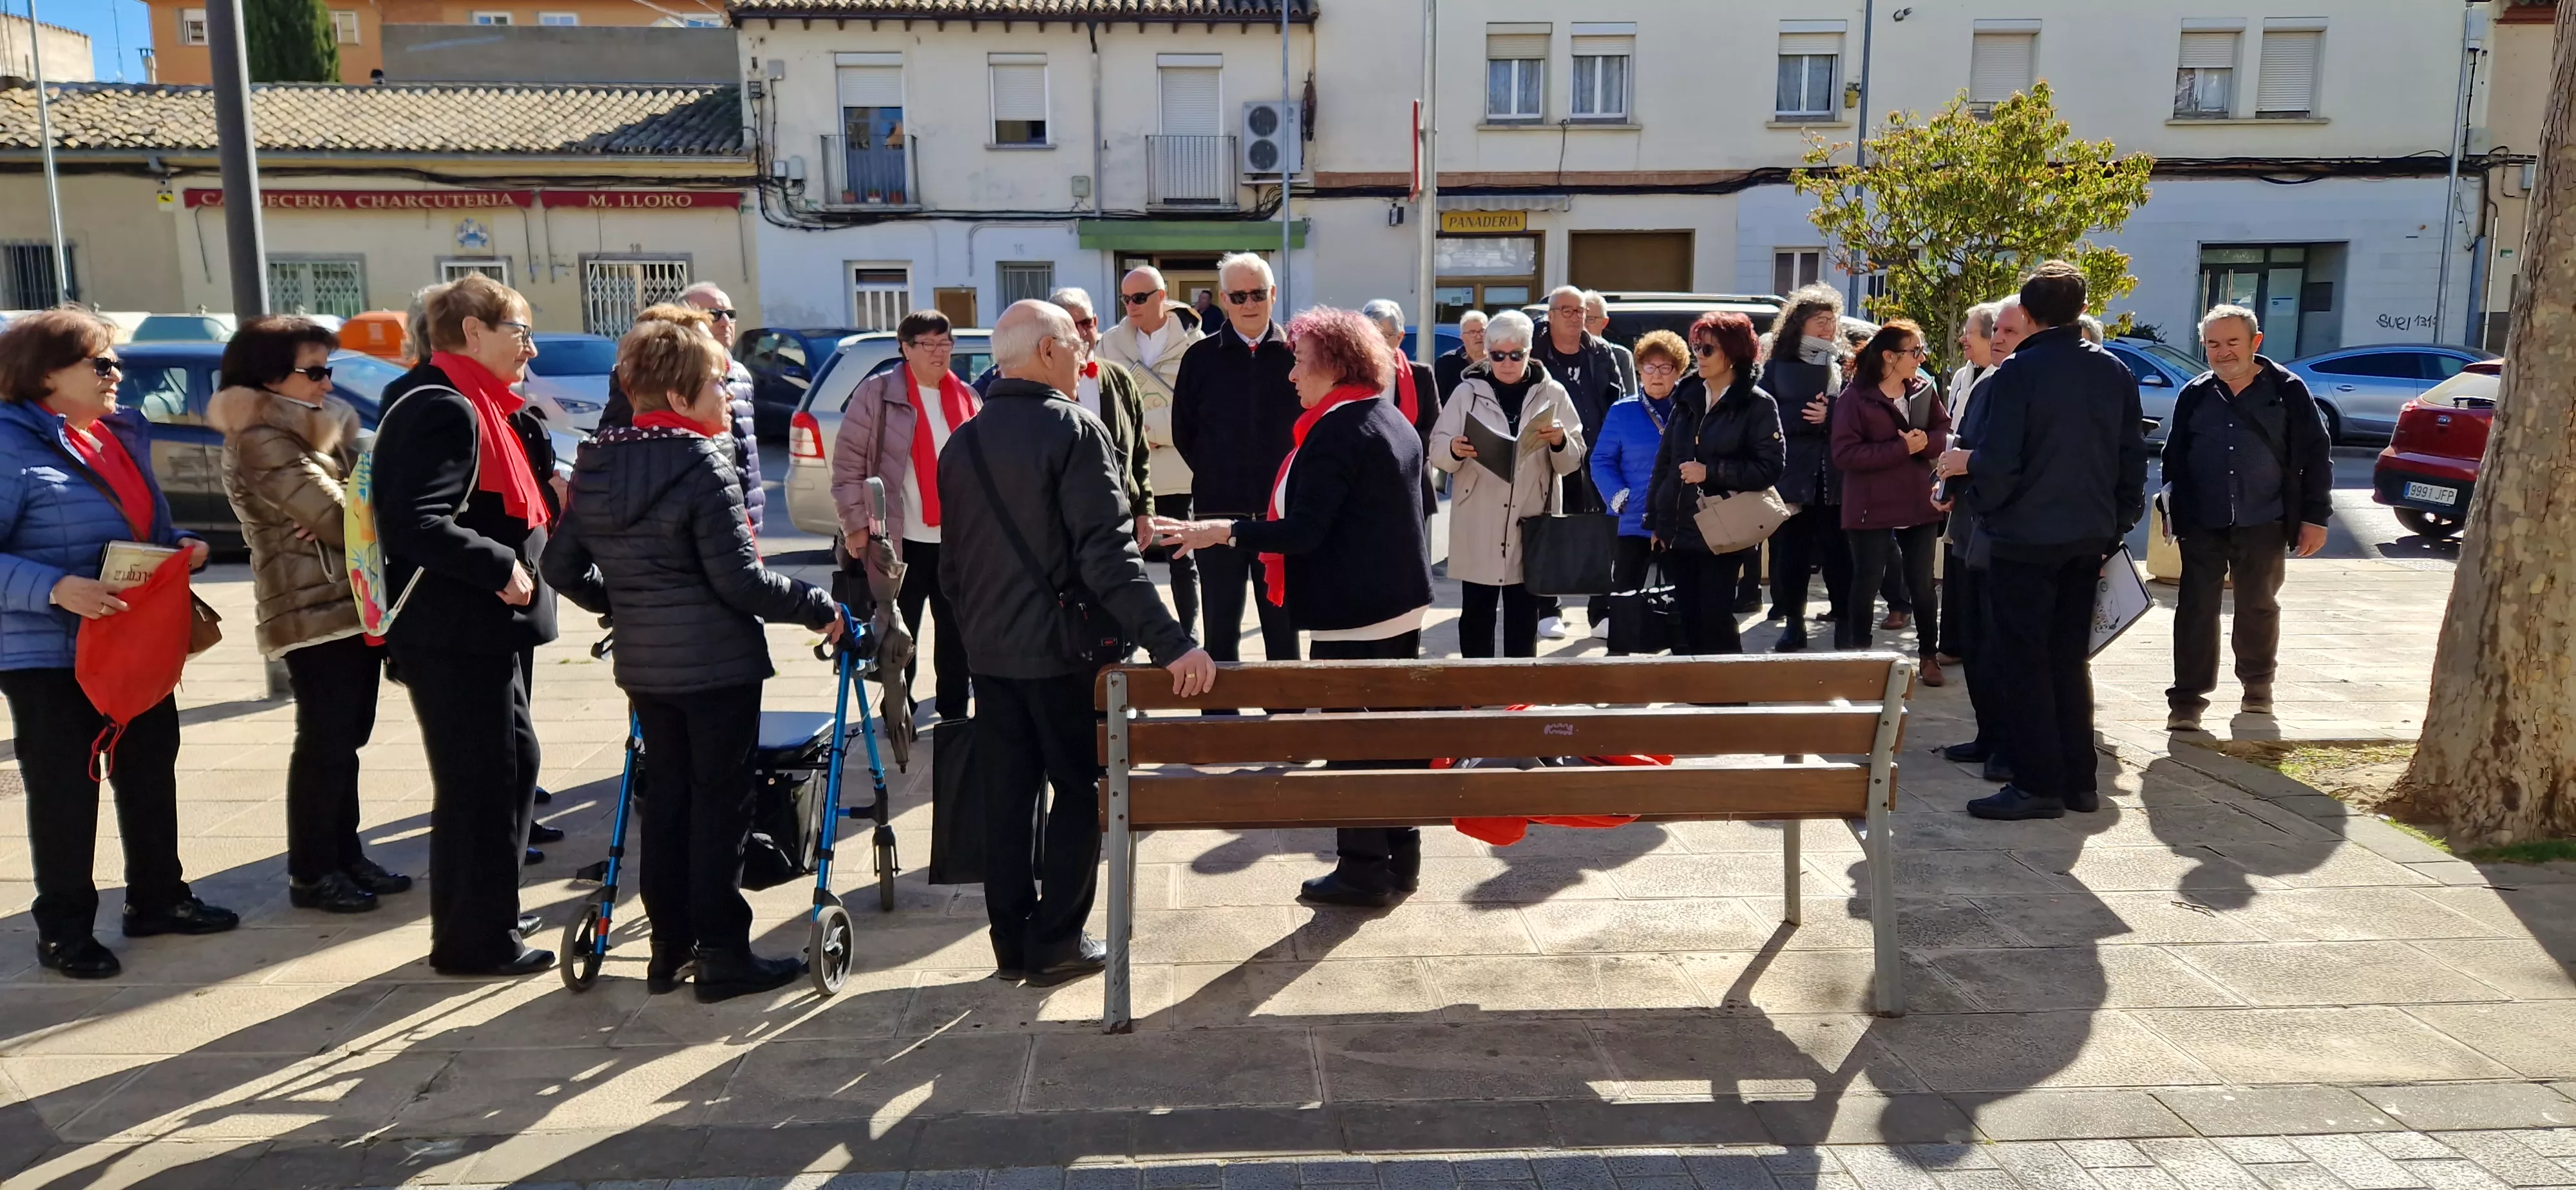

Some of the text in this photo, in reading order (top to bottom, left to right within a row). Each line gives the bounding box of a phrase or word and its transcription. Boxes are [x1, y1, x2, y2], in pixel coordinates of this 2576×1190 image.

[354, 193, 514, 209] CHARCUTERIA
[587, 194, 692, 208] M. LLORO
[2410, 485, 2454, 502] 9991 JFP
